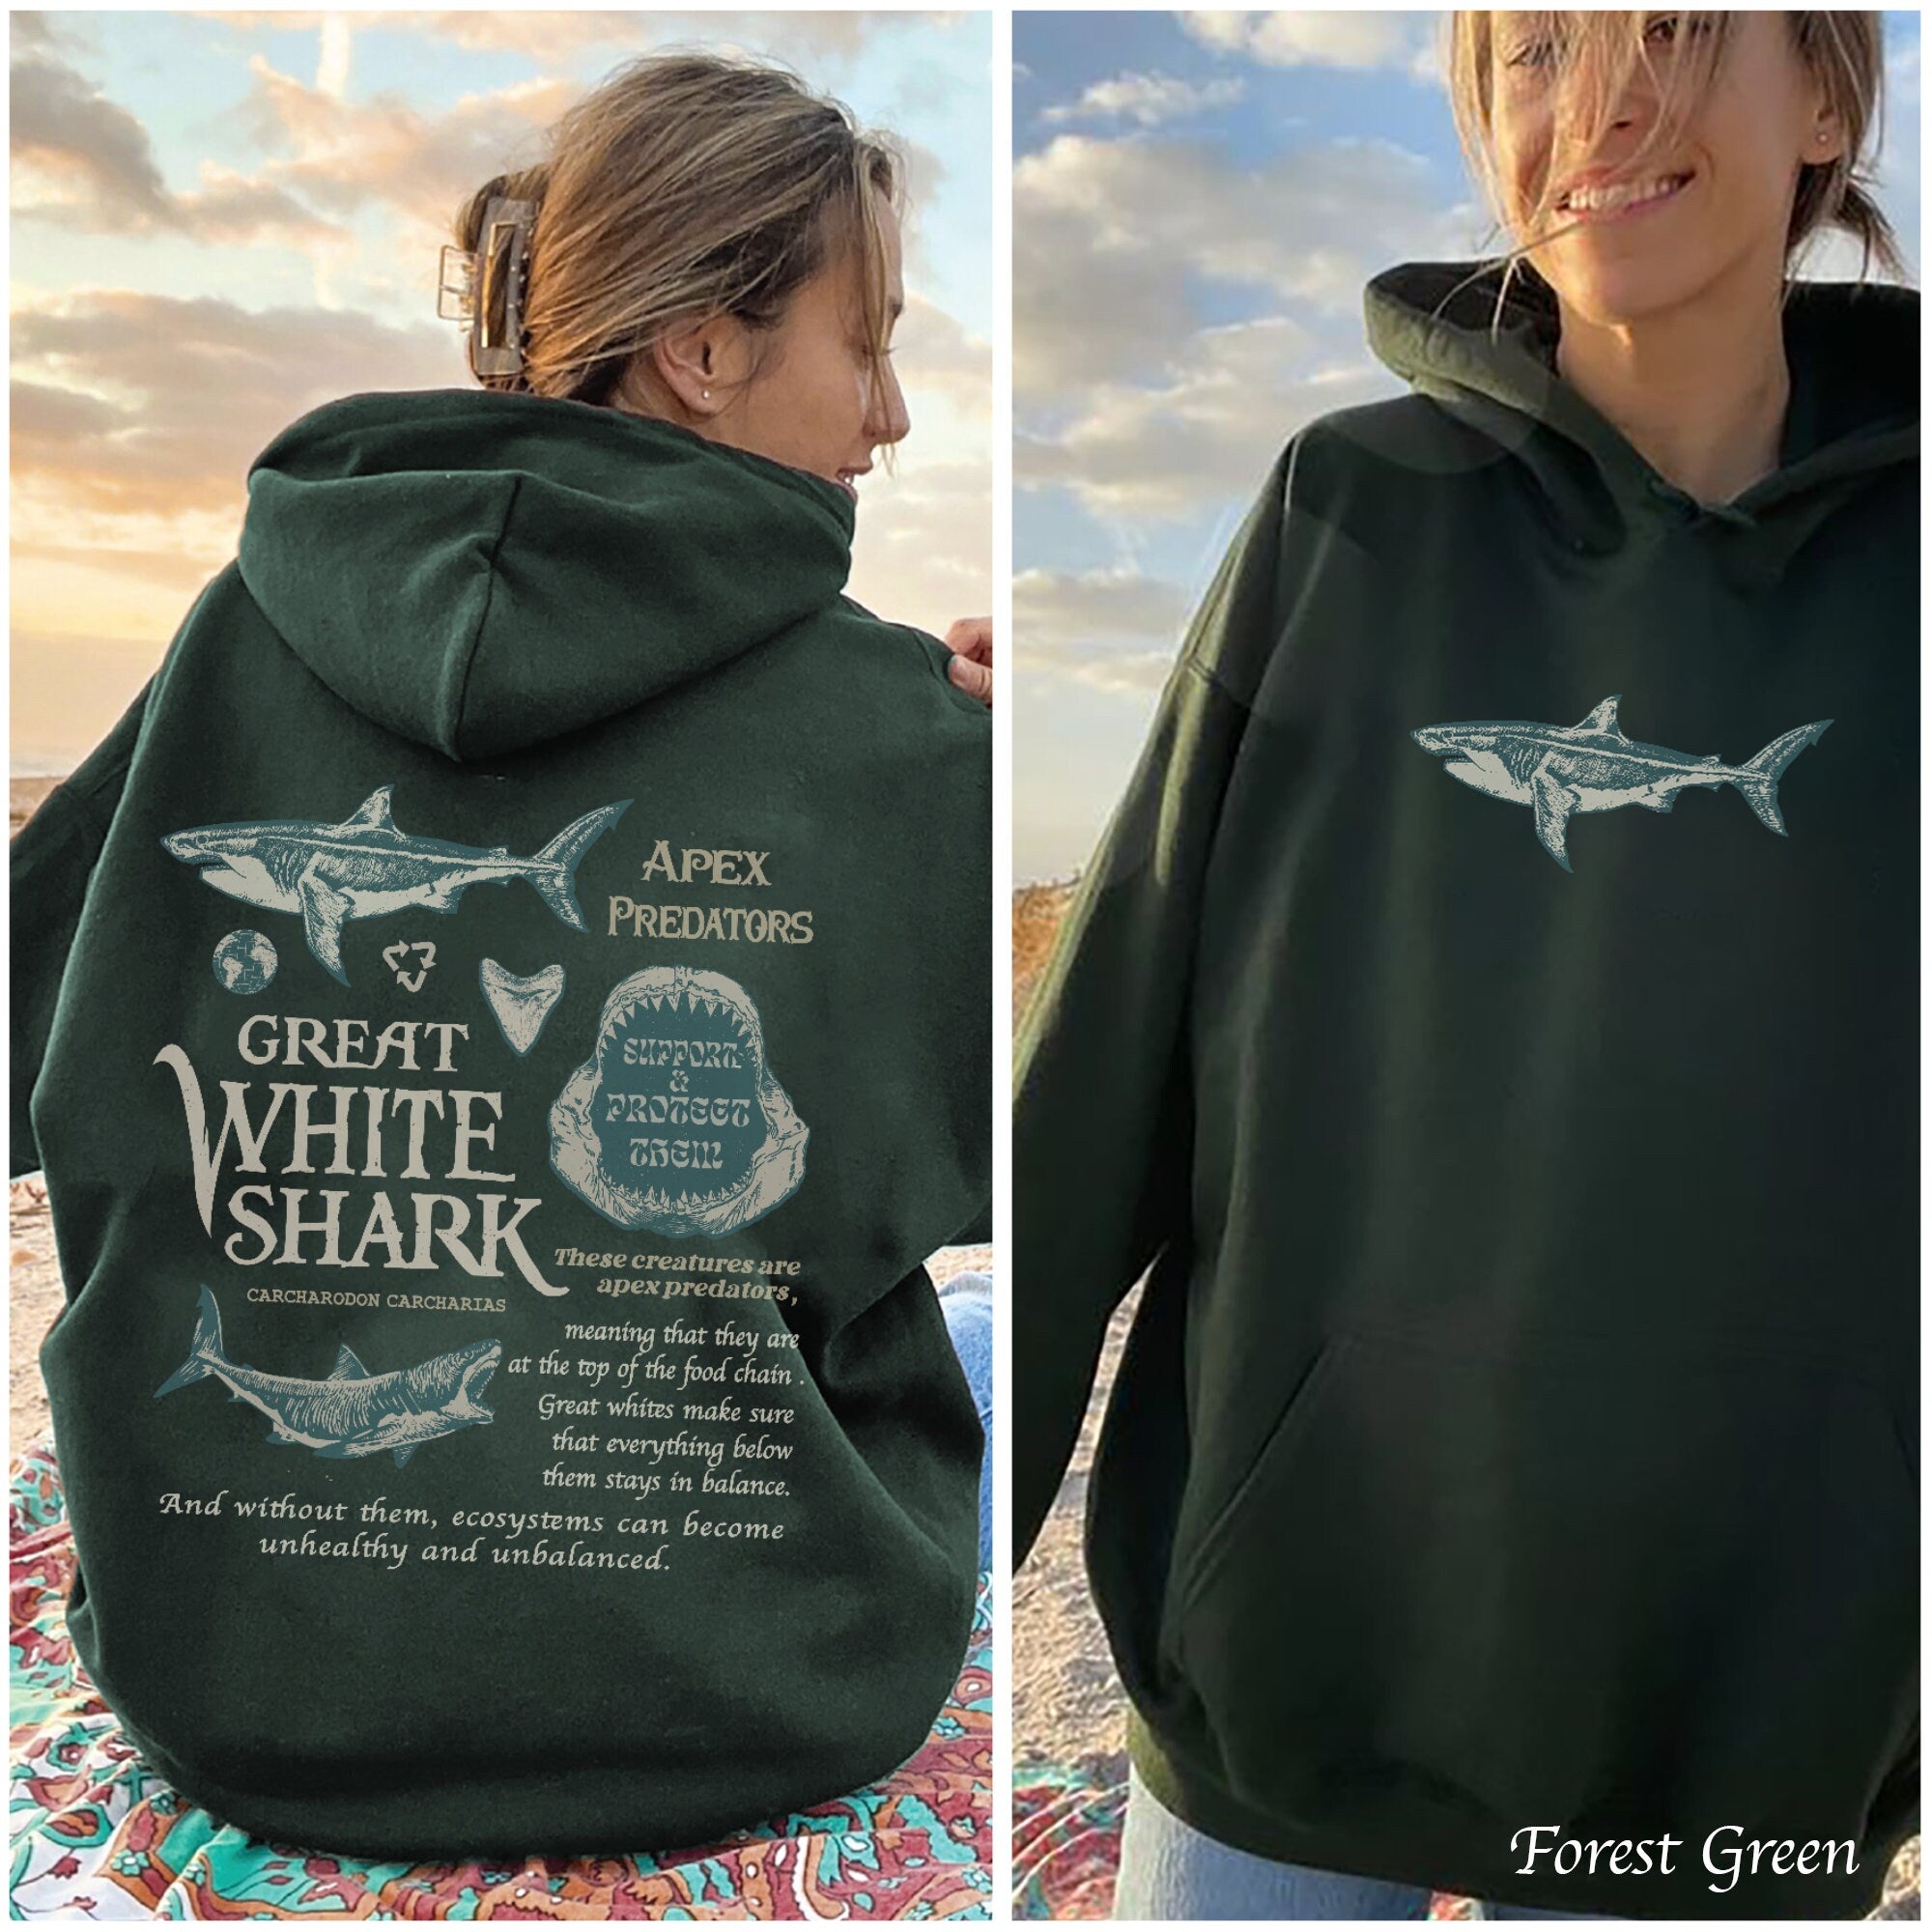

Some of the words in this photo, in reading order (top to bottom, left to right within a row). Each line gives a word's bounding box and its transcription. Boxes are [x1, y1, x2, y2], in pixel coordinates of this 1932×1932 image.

[239, 1014, 469, 1072] GREAT
[623, 1038, 742, 1070] SUPPORT
[669, 1069, 690, 1093] &
[606, 1094, 751, 1126] PROTECT
[153, 1043, 516, 1239] WHITE
[630, 1138, 724, 1170] THEM
[223, 1184, 570, 1296] SHARK
[554, 1247, 627, 1268] These
[631, 1255, 754, 1274] creatures
[757, 1260, 801, 1276] are
[246, 1288, 381, 1307] CARCHARODON
[386, 1294, 506, 1312] CARCHARIAS
[597, 1277, 660, 1297] apex
[663, 1280, 798, 1306] predators,
[565, 1321, 655, 1352] meaning
[664, 1318, 708, 1346] that
[715, 1321, 758, 1357] they
[767, 1331, 799, 1349] are
[508, 1356, 531, 1374] at
[539, 1350, 569, 1376] the
[578, 1359, 610, 1387] top
[617, 1351, 642, 1388] of
[645, 1354, 676, 1380] the
[677, 1355, 733, 1390] food
[538, 1394, 600, 1420] Great
[607, 1392, 674, 1419] whites
[683, 1397, 741, 1421] make
[750, 1406, 794, 1424] sure
[553, 1426, 599, 1452] that
[607, 1431, 724, 1467] everything
[733, 1433, 793, 1460] below
[543, 1462, 597, 1488] them
[605, 1471, 660, 1500] stays
[670, 1471, 693, 1492] in
[702, 1468, 790, 1496] balance.
[159, 1491, 229, 1517] And
[235, 1492, 348, 1522] without
[360, 1494, 438, 1529] them,
[452, 1509, 605, 1539] ecosystems
[617, 1515, 668, 1535] can
[683, 1510, 784, 1540] become
[259, 1529, 408, 1569] unhealthy
[421, 1537, 485, 1563] and
[492, 1540, 670, 1572] unbalanced.
